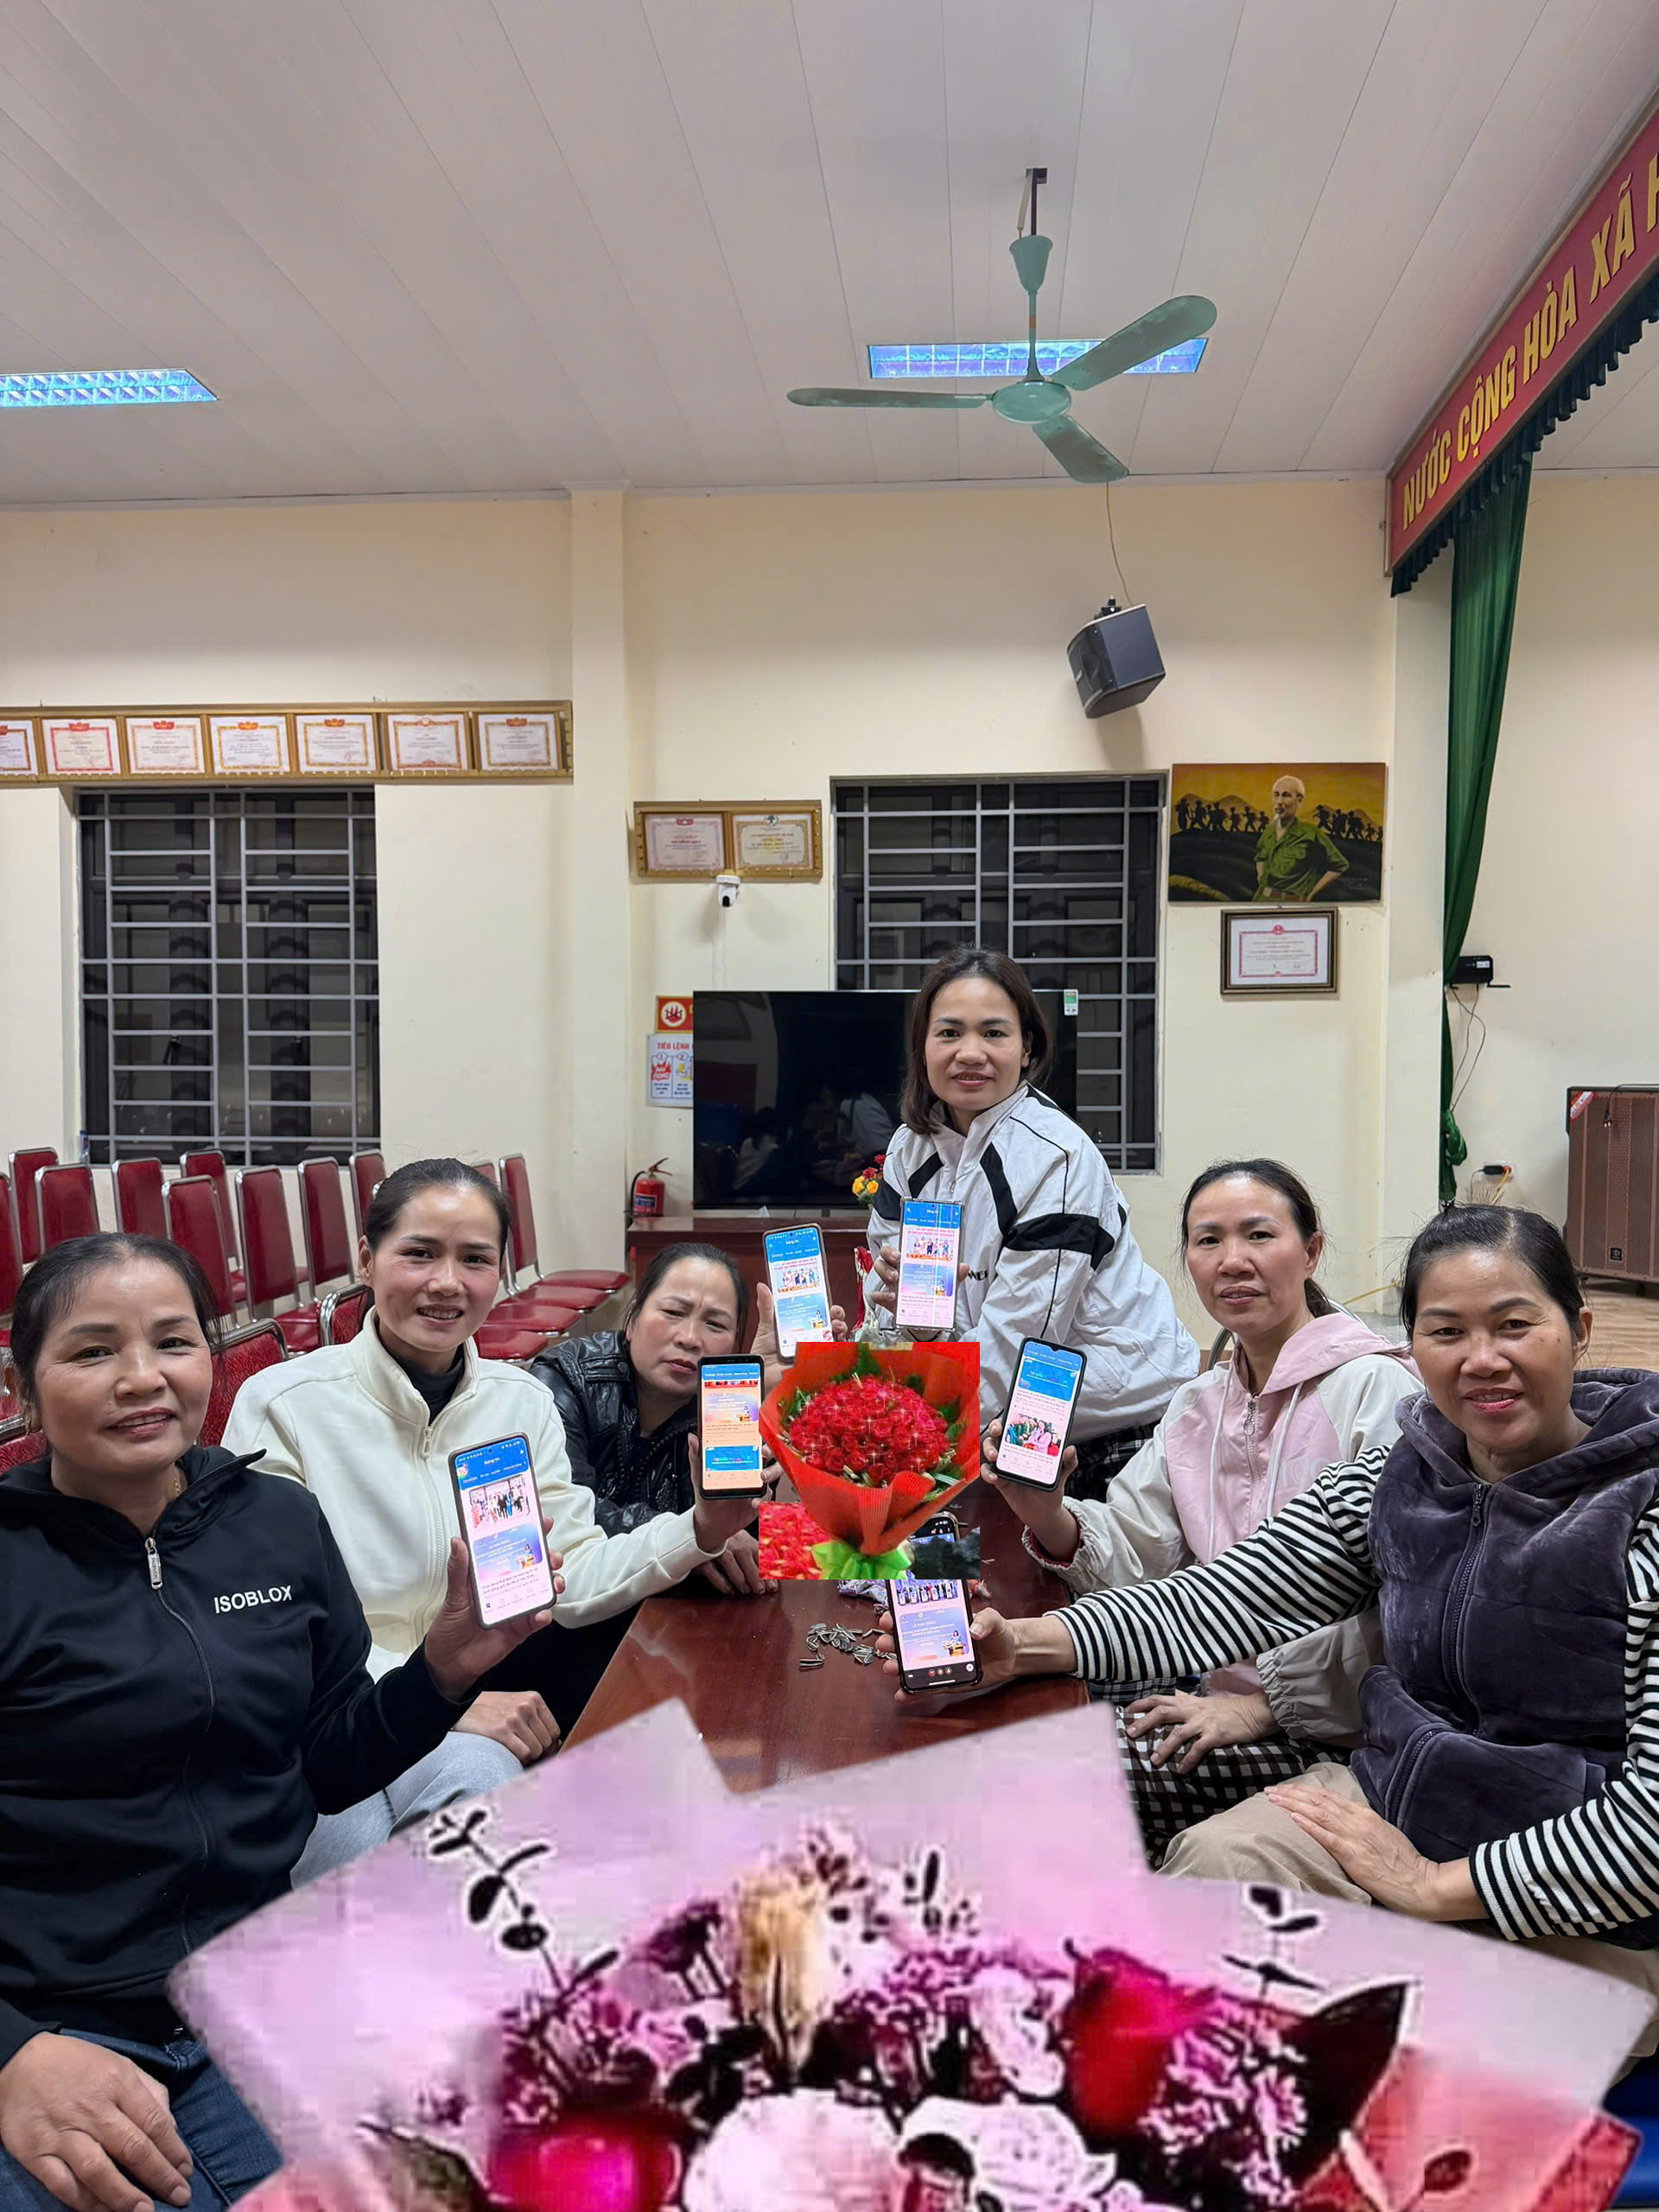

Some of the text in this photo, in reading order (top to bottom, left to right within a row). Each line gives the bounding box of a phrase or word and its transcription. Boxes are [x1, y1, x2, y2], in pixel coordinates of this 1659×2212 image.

[1403, 428, 1452, 531] NƯỚC
[1457, 345, 1516, 462] CỘNG
[1523, 265, 1578, 385] HÒA
[1589, 173, 1636, 304] XÃ
[213, 1586, 292, 1613] ISOBLOX
